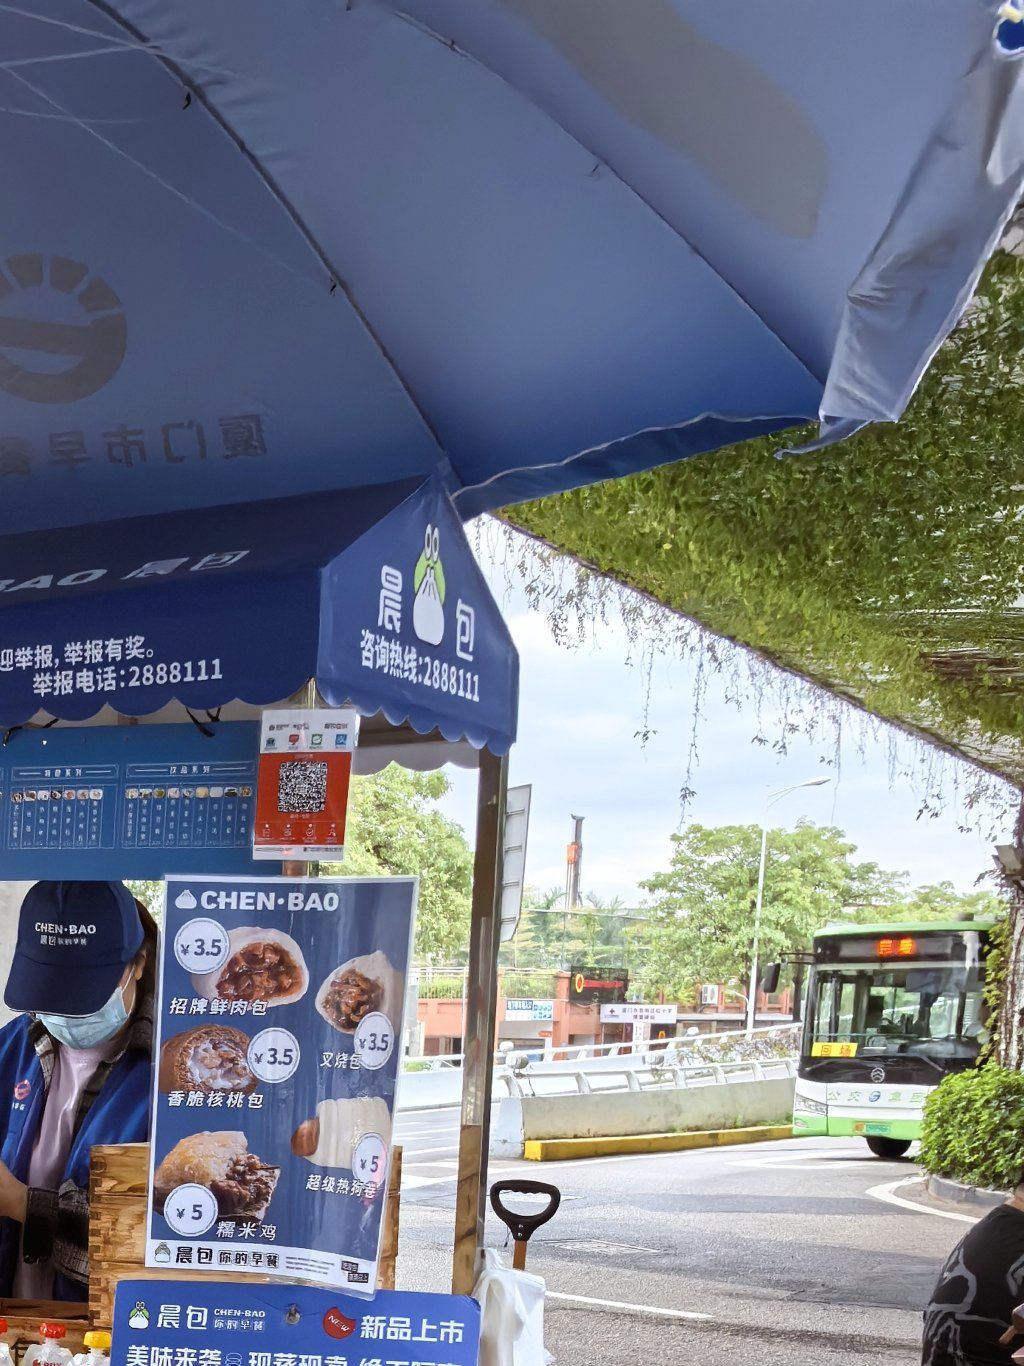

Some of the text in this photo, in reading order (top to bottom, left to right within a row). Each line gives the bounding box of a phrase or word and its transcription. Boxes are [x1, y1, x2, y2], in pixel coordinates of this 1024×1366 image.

[377, 565, 476, 664] 晨 包
[359, 627, 481, 704] 咨询热线:2888111
[31, 657, 224, 699] 举报电话:2888111
[201, 891, 339, 911] CHEN·BAO
[34, 922, 97, 936] CHEN·BAO
[169, 998, 268, 1016] 招牌鲜肉包
[320, 1052, 363, 1070] 叉烧包
[167, 1090, 264, 1109] 香脆核桃包
[216, 1221, 277, 1240] 糯米鸡
[175, 1246, 213, 1265] 晨包
[219, 1251, 279, 1269] 你的早餐
[157, 1304, 208, 1331] 晨包
[327, 1314, 350, 1332] NEW
[360, 1315, 464, 1344] 新品上市
